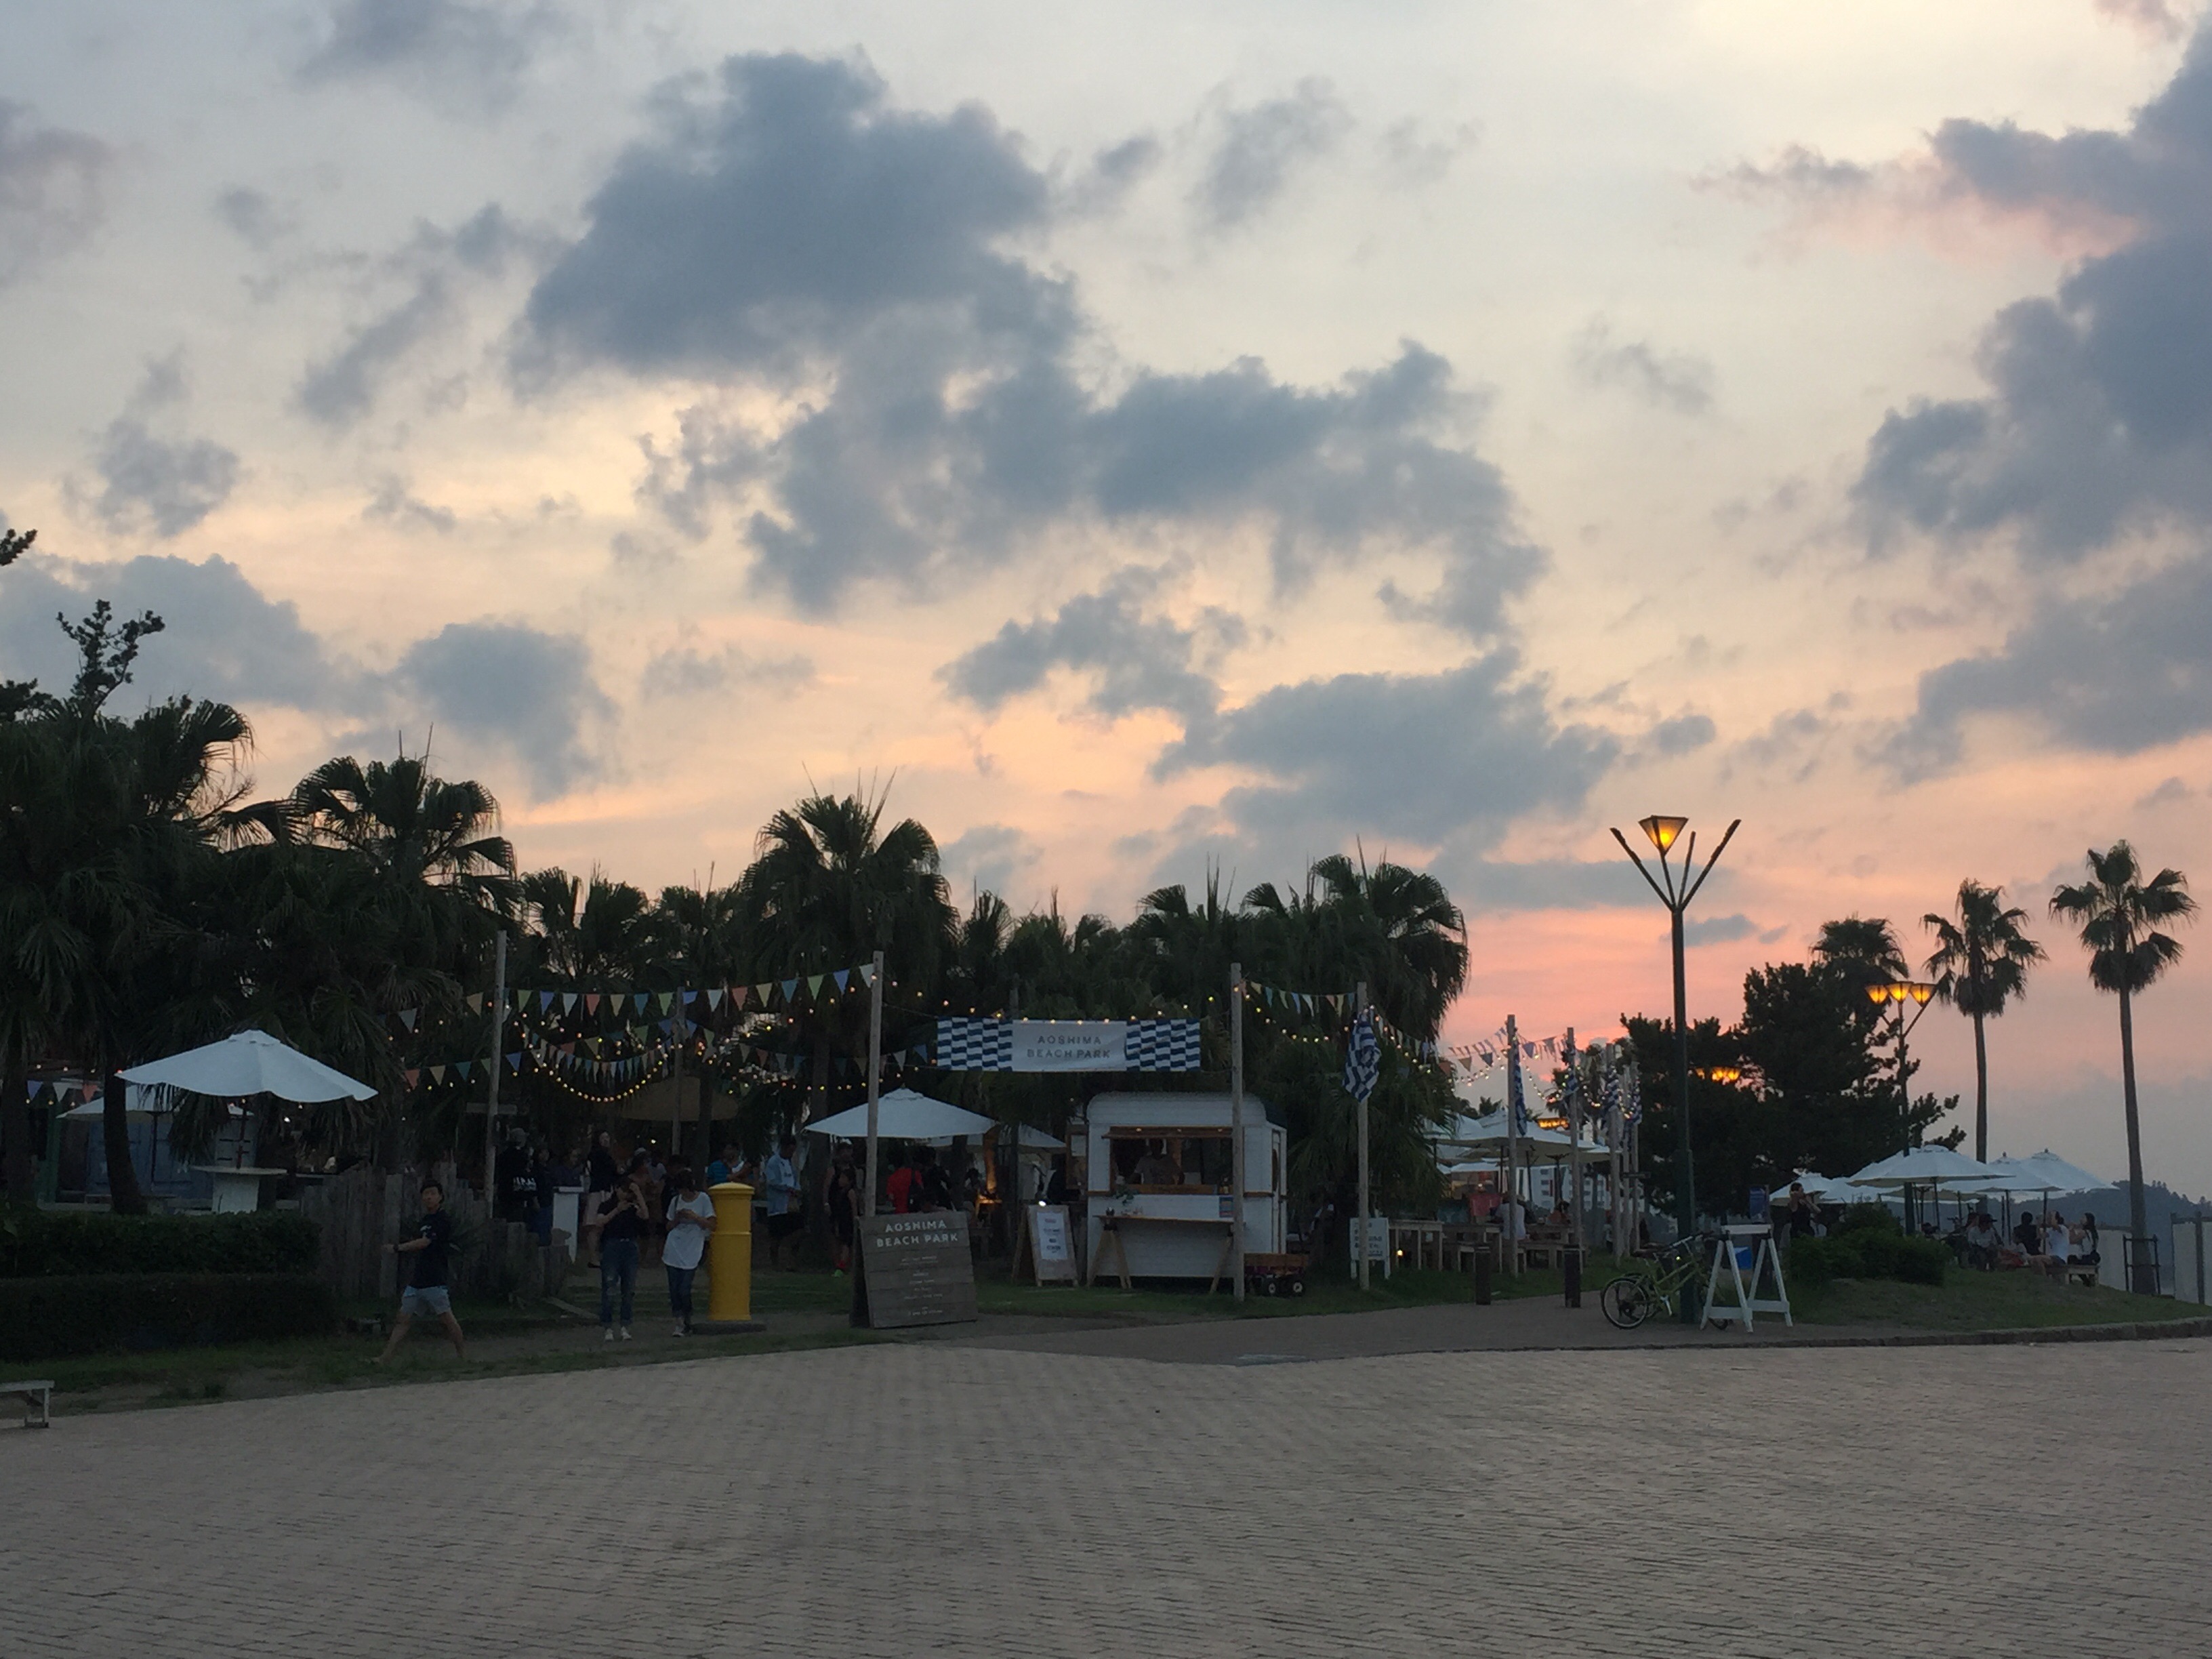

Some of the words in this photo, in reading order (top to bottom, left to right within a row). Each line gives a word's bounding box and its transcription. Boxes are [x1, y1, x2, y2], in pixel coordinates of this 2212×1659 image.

[1038, 1035, 1101, 1044] AOSHIMA
[1027, 1049, 1072, 1058] BEACH
[1077, 1049, 1110, 1059] PARK
[885, 1219, 947, 1233] AOSHIMA
[876, 1235, 920, 1248] BEACH
[924, 1233, 958, 1243] PARK
